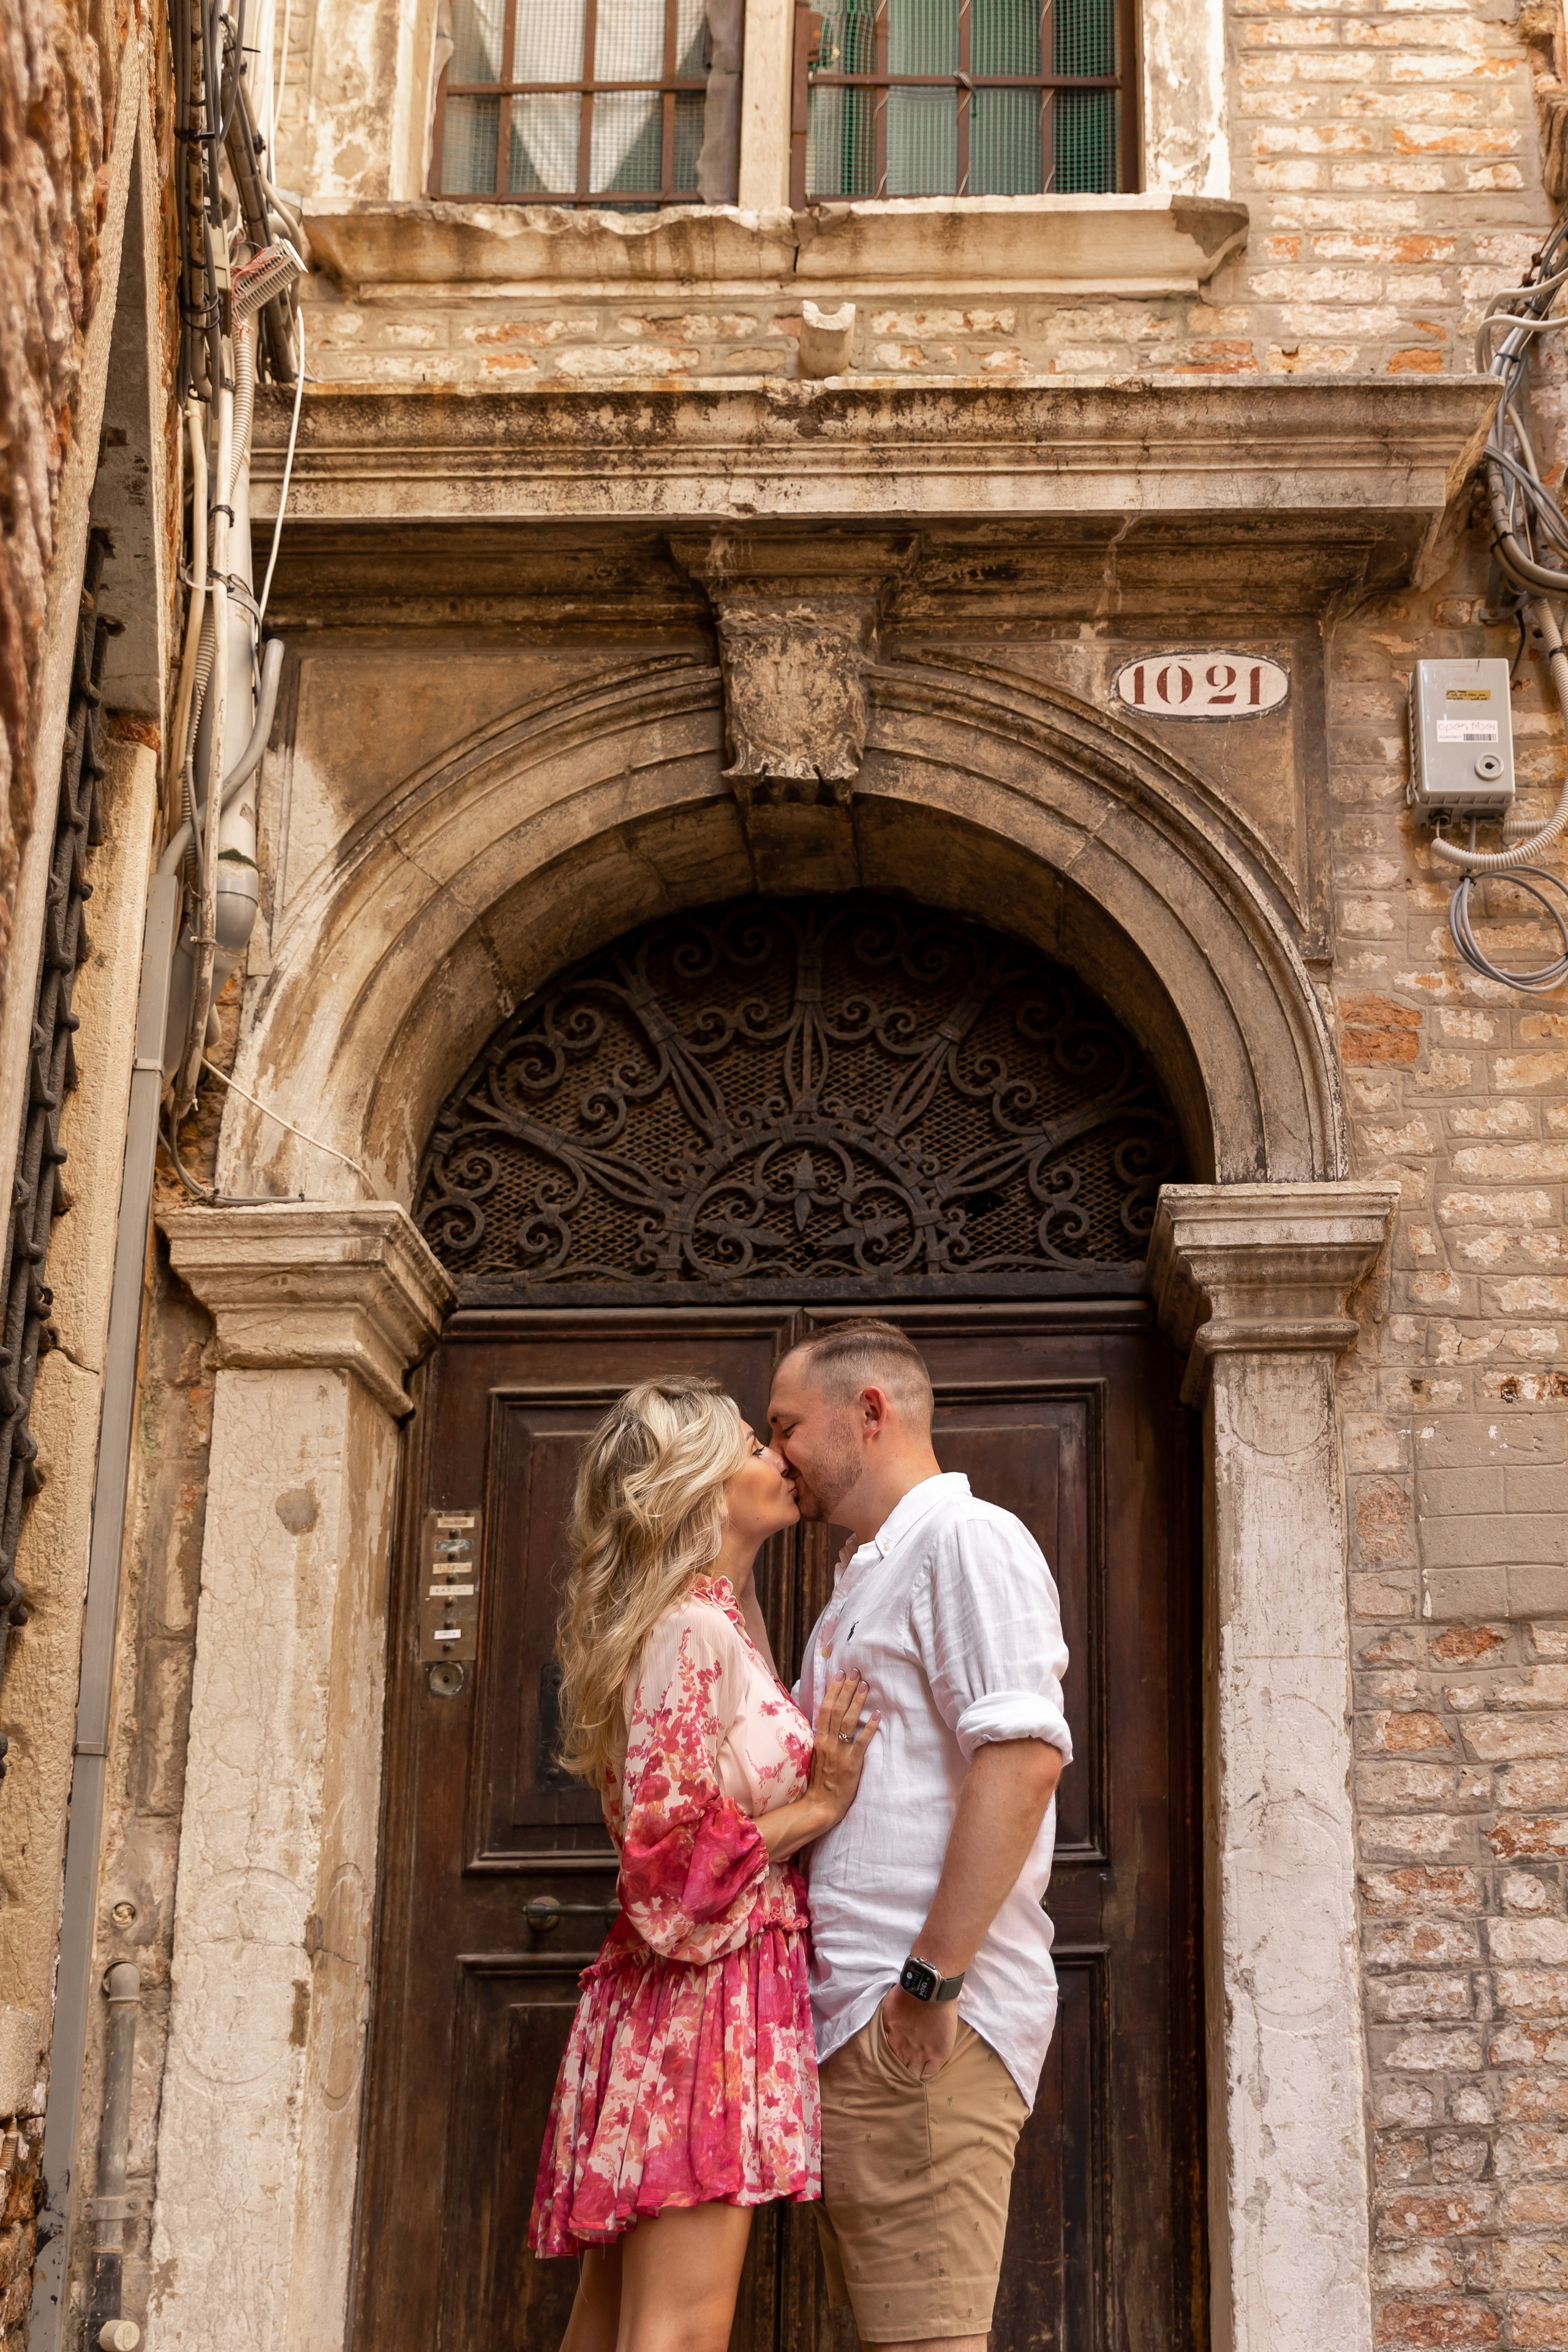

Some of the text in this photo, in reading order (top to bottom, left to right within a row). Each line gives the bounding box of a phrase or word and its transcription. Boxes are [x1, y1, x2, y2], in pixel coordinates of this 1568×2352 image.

[1132, 666, 1262, 704] 1021
[1438, 723, 1468, 732] open
[919, 1981, 927, 1996] 13:04
